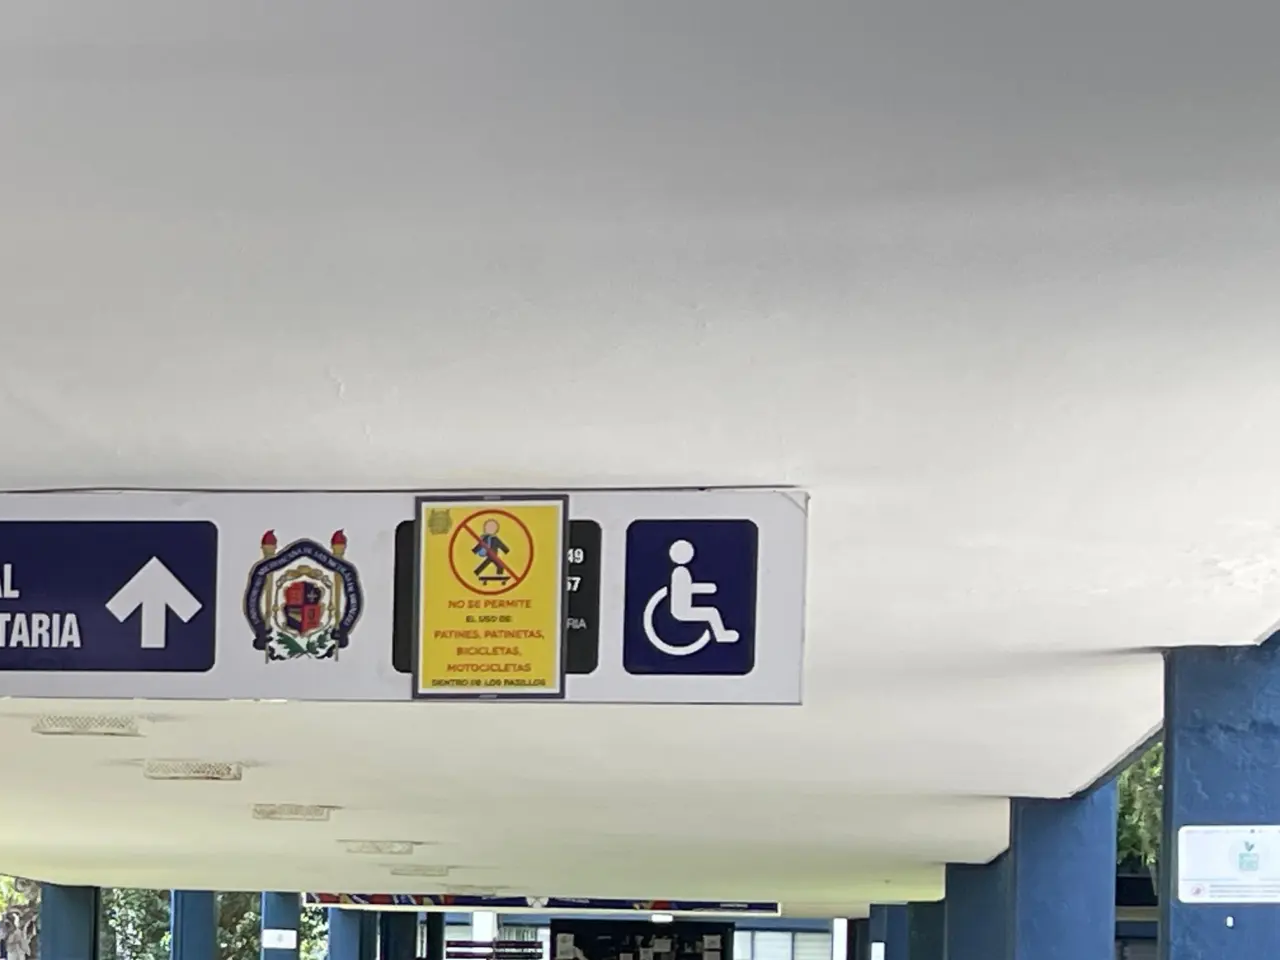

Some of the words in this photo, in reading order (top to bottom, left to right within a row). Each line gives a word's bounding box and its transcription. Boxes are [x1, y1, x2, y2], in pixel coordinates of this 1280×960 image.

[448, 600, 465, 608] NO
[468, 600, 480, 608] SE
[484, 600, 532, 608] PERMITE
